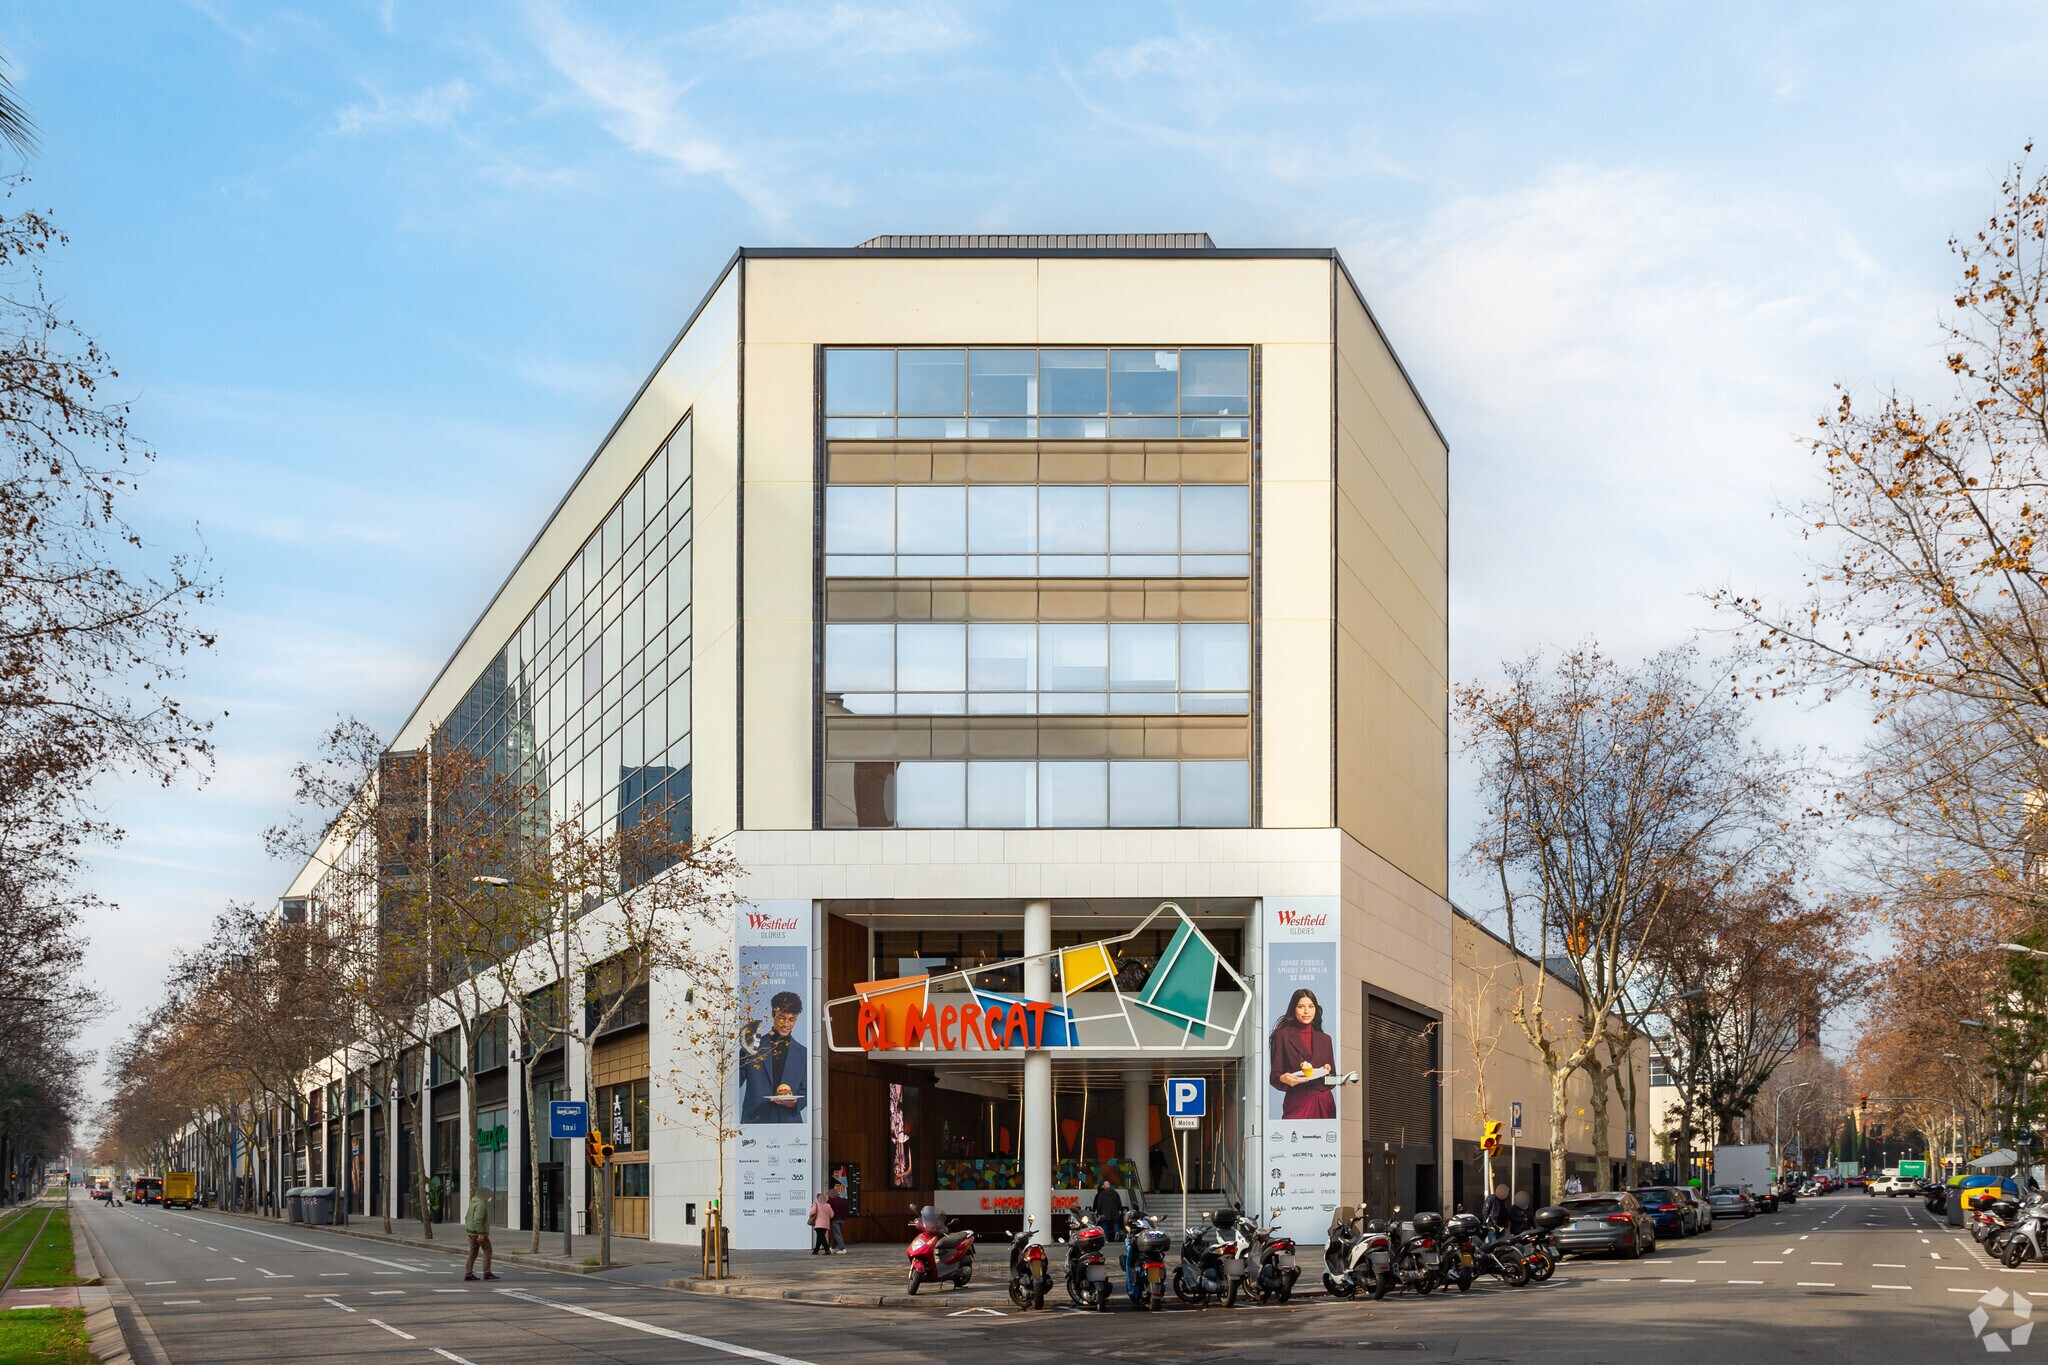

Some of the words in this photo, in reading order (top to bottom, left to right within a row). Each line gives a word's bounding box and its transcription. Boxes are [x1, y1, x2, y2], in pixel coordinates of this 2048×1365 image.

[746, 912, 799, 930] Westfield
[1277, 909, 1328, 926] Westfield
[1175, 1083, 1198, 1112] P
[1513, 1105, 1520, 1126] P
[1629, 1133, 1635, 1148] P
[791, 1173, 804, 1181] 365
